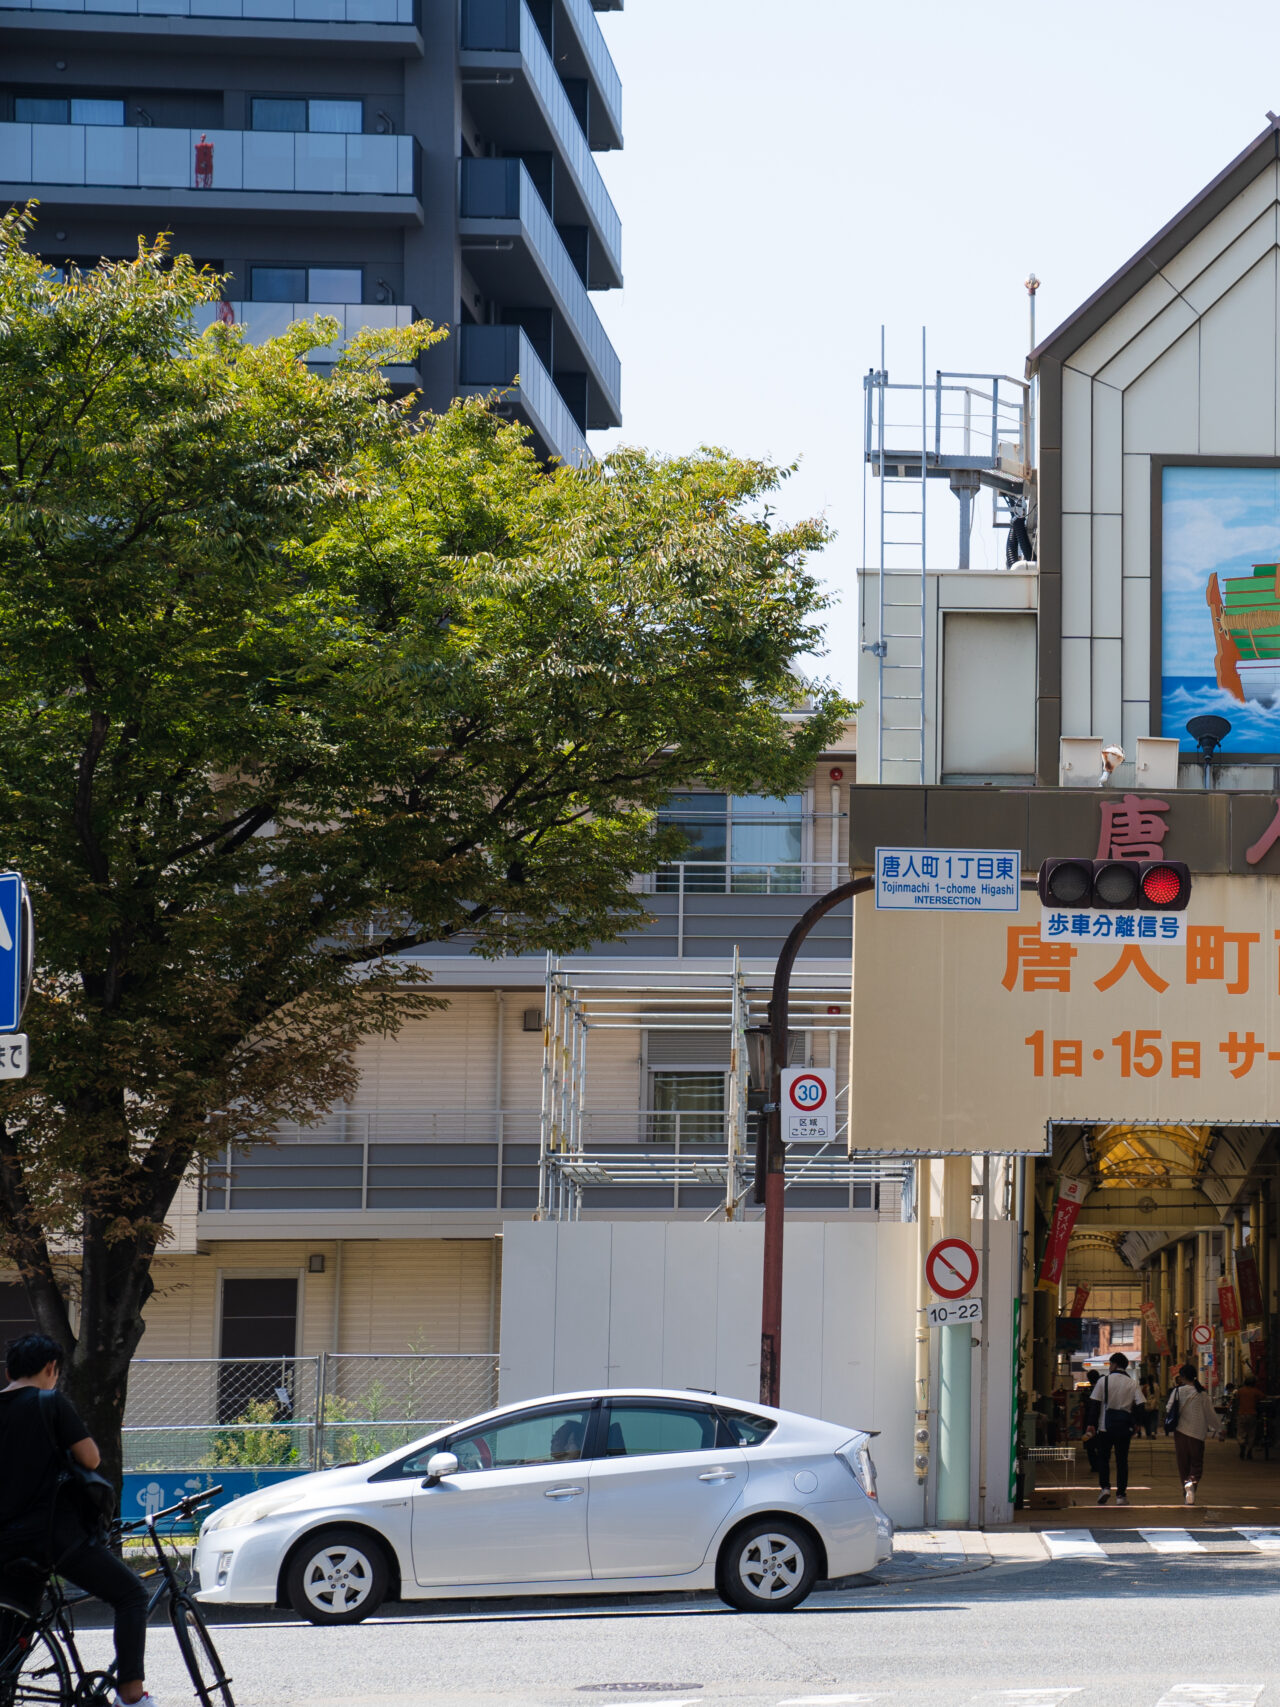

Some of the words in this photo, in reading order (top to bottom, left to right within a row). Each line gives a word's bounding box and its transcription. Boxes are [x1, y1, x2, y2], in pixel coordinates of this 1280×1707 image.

[882, 855, 1014, 881] 唐人町1丁目東
[882, 881, 930, 894] Tojinmachi
[935, 883, 976, 894] 1-chome
[981, 884, 1014, 896] Higashi
[914, 896, 981, 906] INTERSECTION
[1048, 913, 1180, 939] 歩車分離信号
[798, 1085, 819, 1101] 30
[792, 1128, 826, 1136] ここから
[930, 1304, 979, 1322] 10-22
